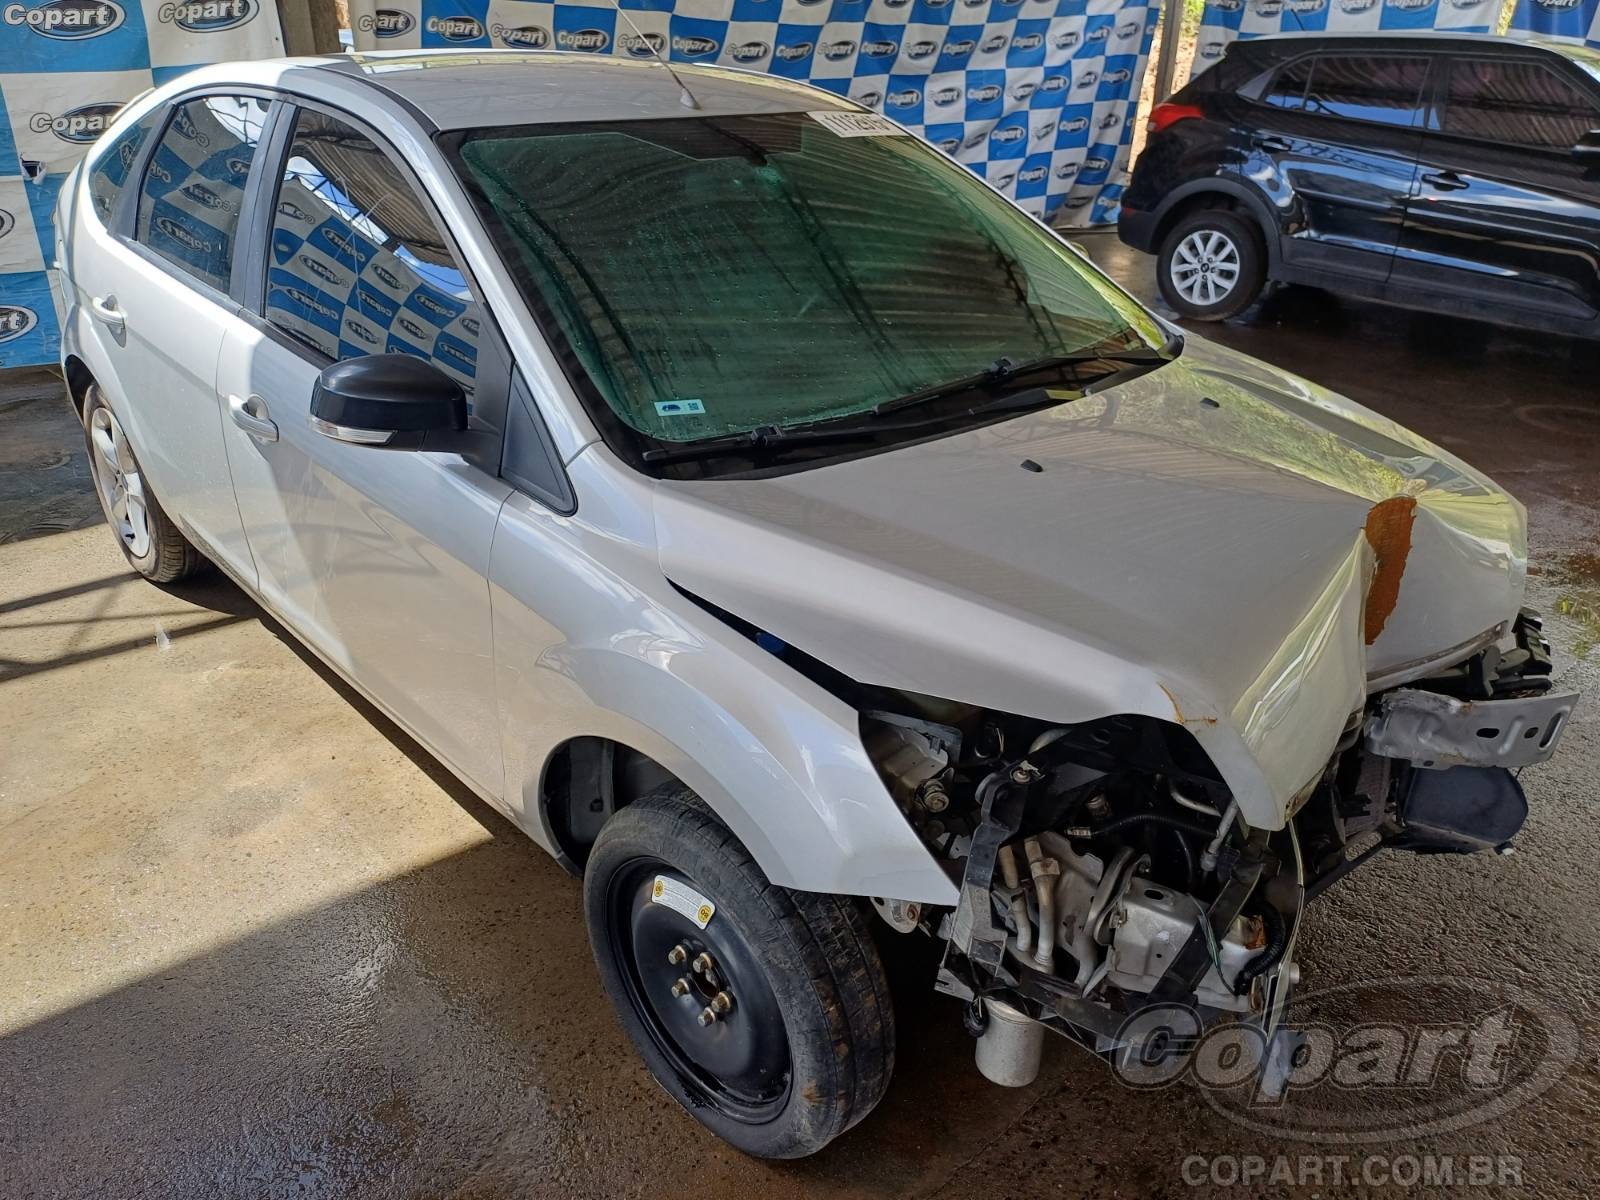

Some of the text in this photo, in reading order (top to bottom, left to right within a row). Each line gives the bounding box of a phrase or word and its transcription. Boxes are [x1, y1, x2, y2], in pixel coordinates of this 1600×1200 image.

[4, 4, 109, 30] Copart
[158, 0, 243, 24] Copart
[427, 17, 481, 36] Copart
[490, 23, 545, 44] Copart
[558, 31, 602, 48] Copart
[617, 33, 660, 52] Copart
[672, 36, 713, 53] Copart
[726, 43, 764, 59] Copart
[30, 112, 112, 136] Copar
